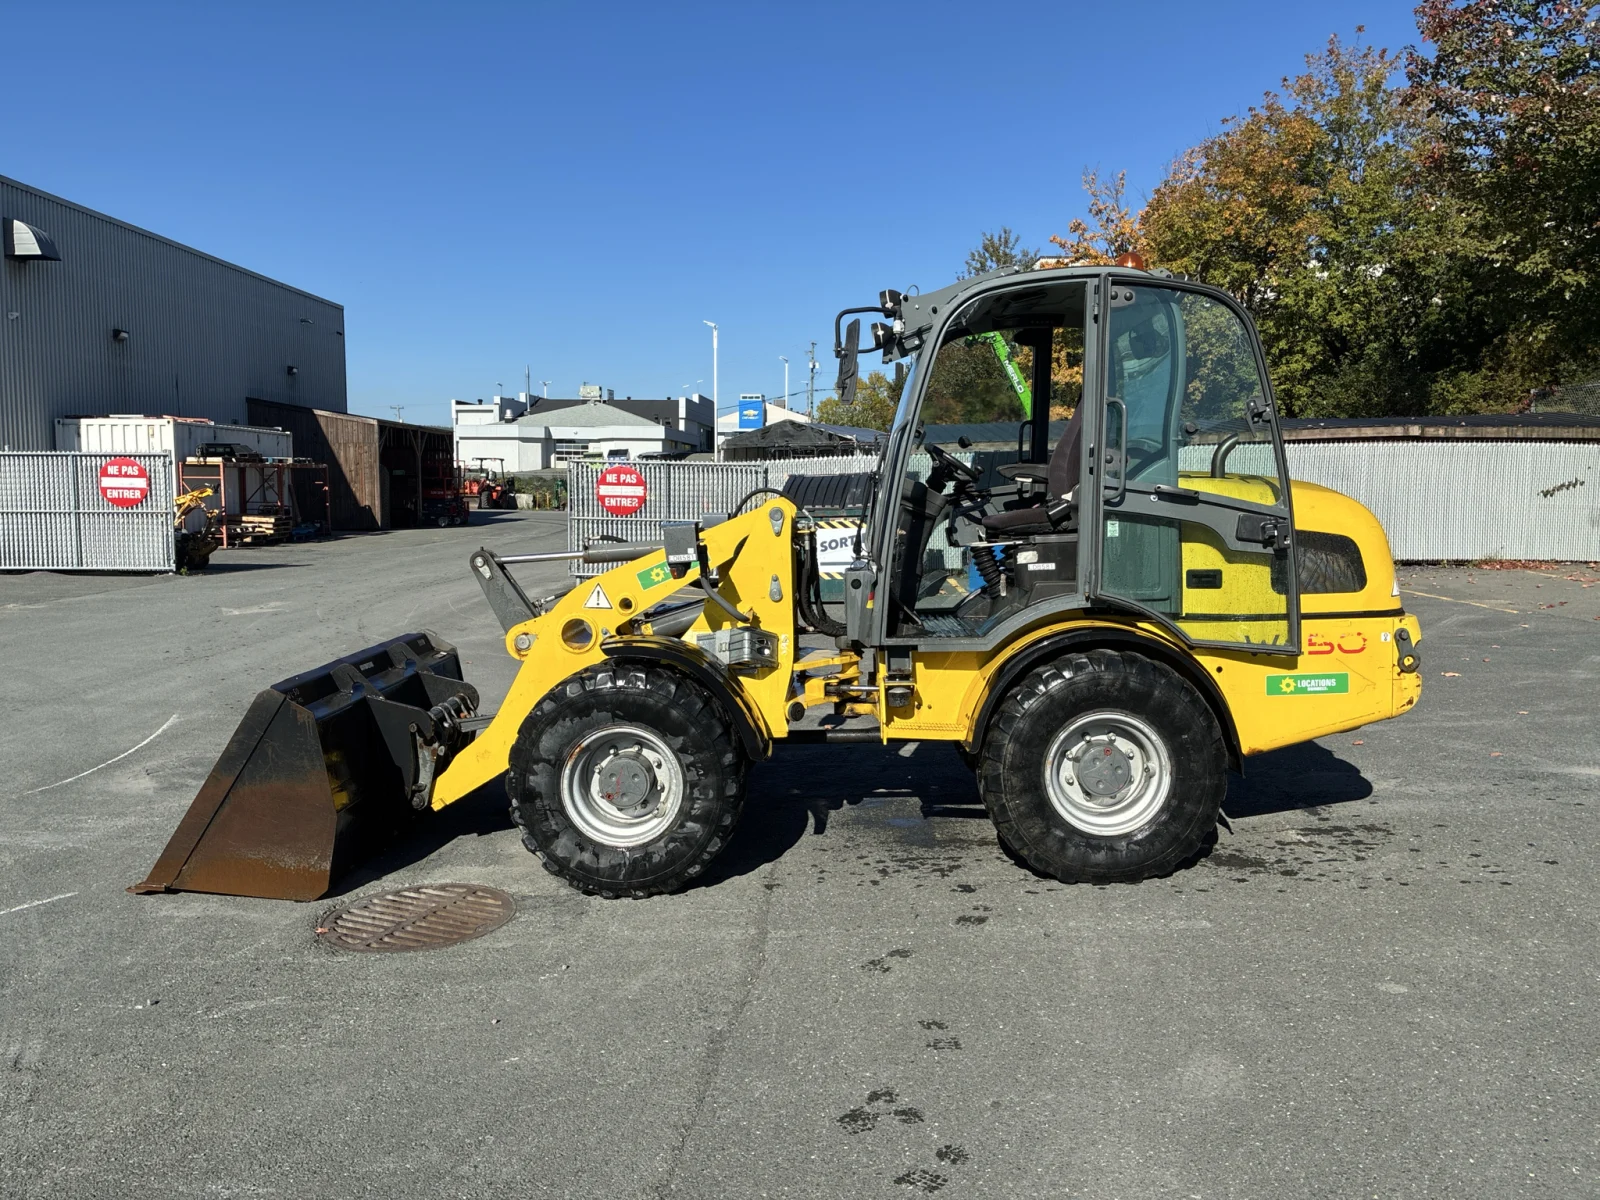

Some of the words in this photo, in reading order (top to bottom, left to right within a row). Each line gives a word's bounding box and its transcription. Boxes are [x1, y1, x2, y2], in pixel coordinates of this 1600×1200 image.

[1003, 360, 1024, 393] MERLO
[107, 465, 119, 475] NE
[121, 465, 139, 476] PAS
[606, 473, 618, 483] NE
[620, 474, 637, 484] PAS
[106, 489, 141, 499] ENTRER
[1297, 678, 1337, 688] LOCATIONS
